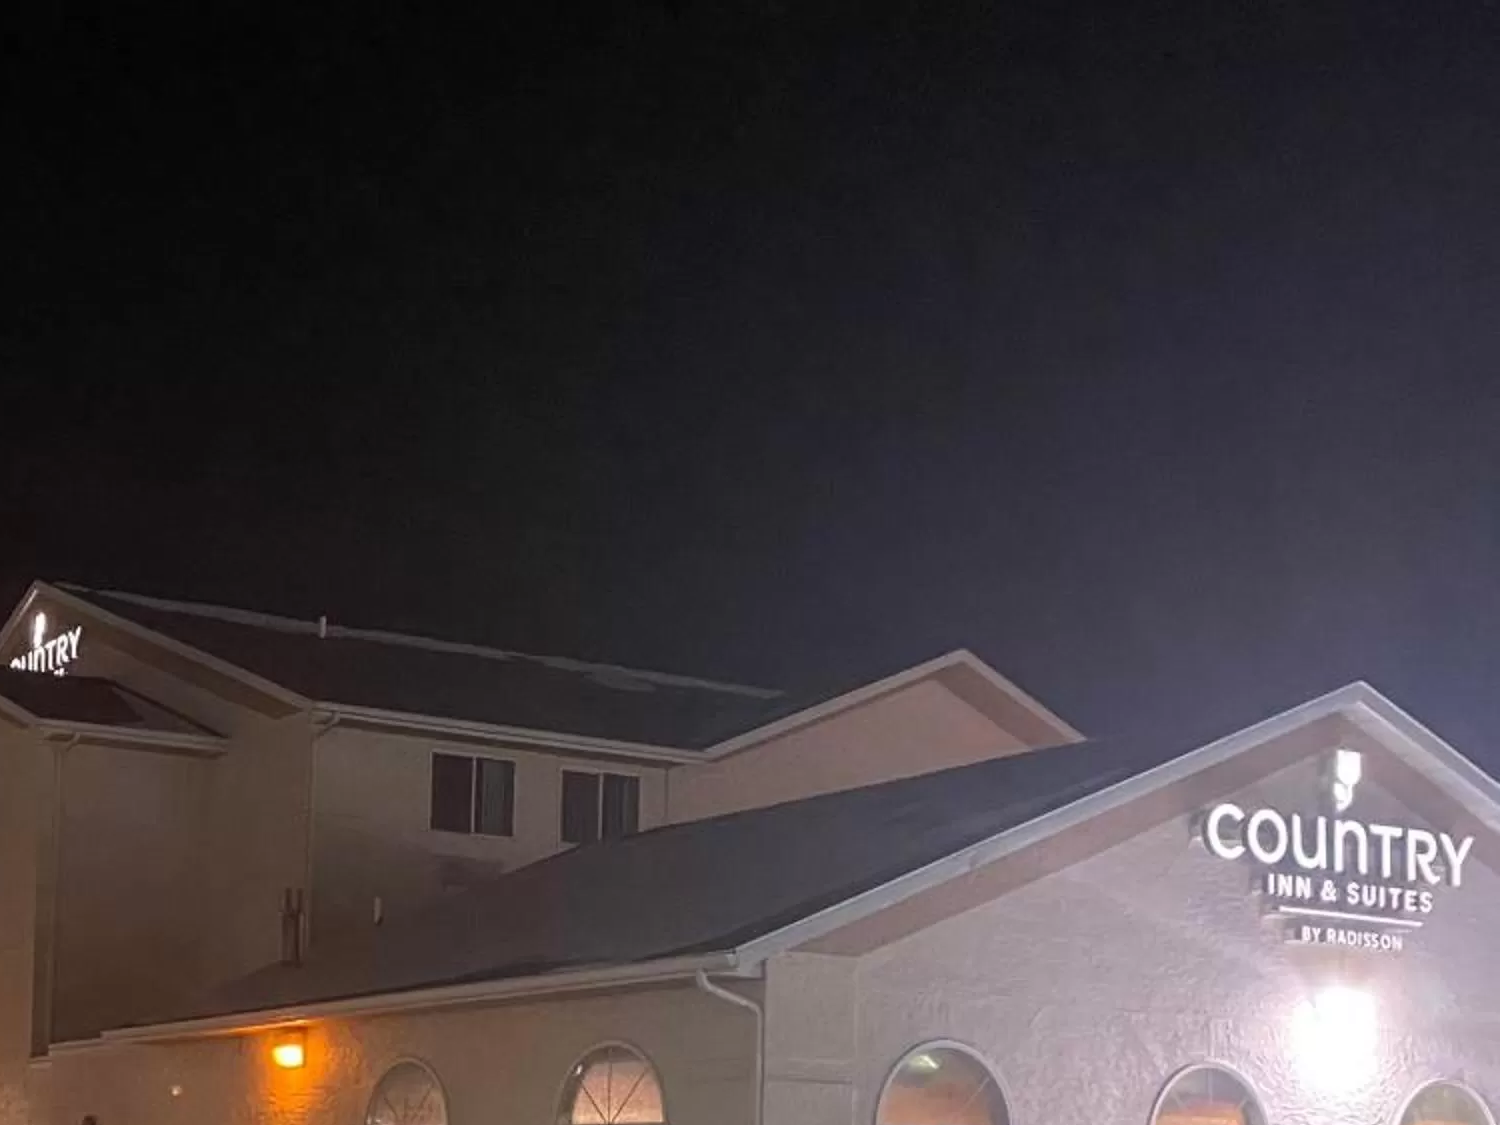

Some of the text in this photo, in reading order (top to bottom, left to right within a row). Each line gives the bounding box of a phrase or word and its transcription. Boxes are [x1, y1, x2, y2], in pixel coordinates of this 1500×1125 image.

[1207, 803, 1474, 887] COUNTRY
[1267, 873, 1433, 913] INN & SUITES
[1301, 926, 1403, 952] BY RADISSON
